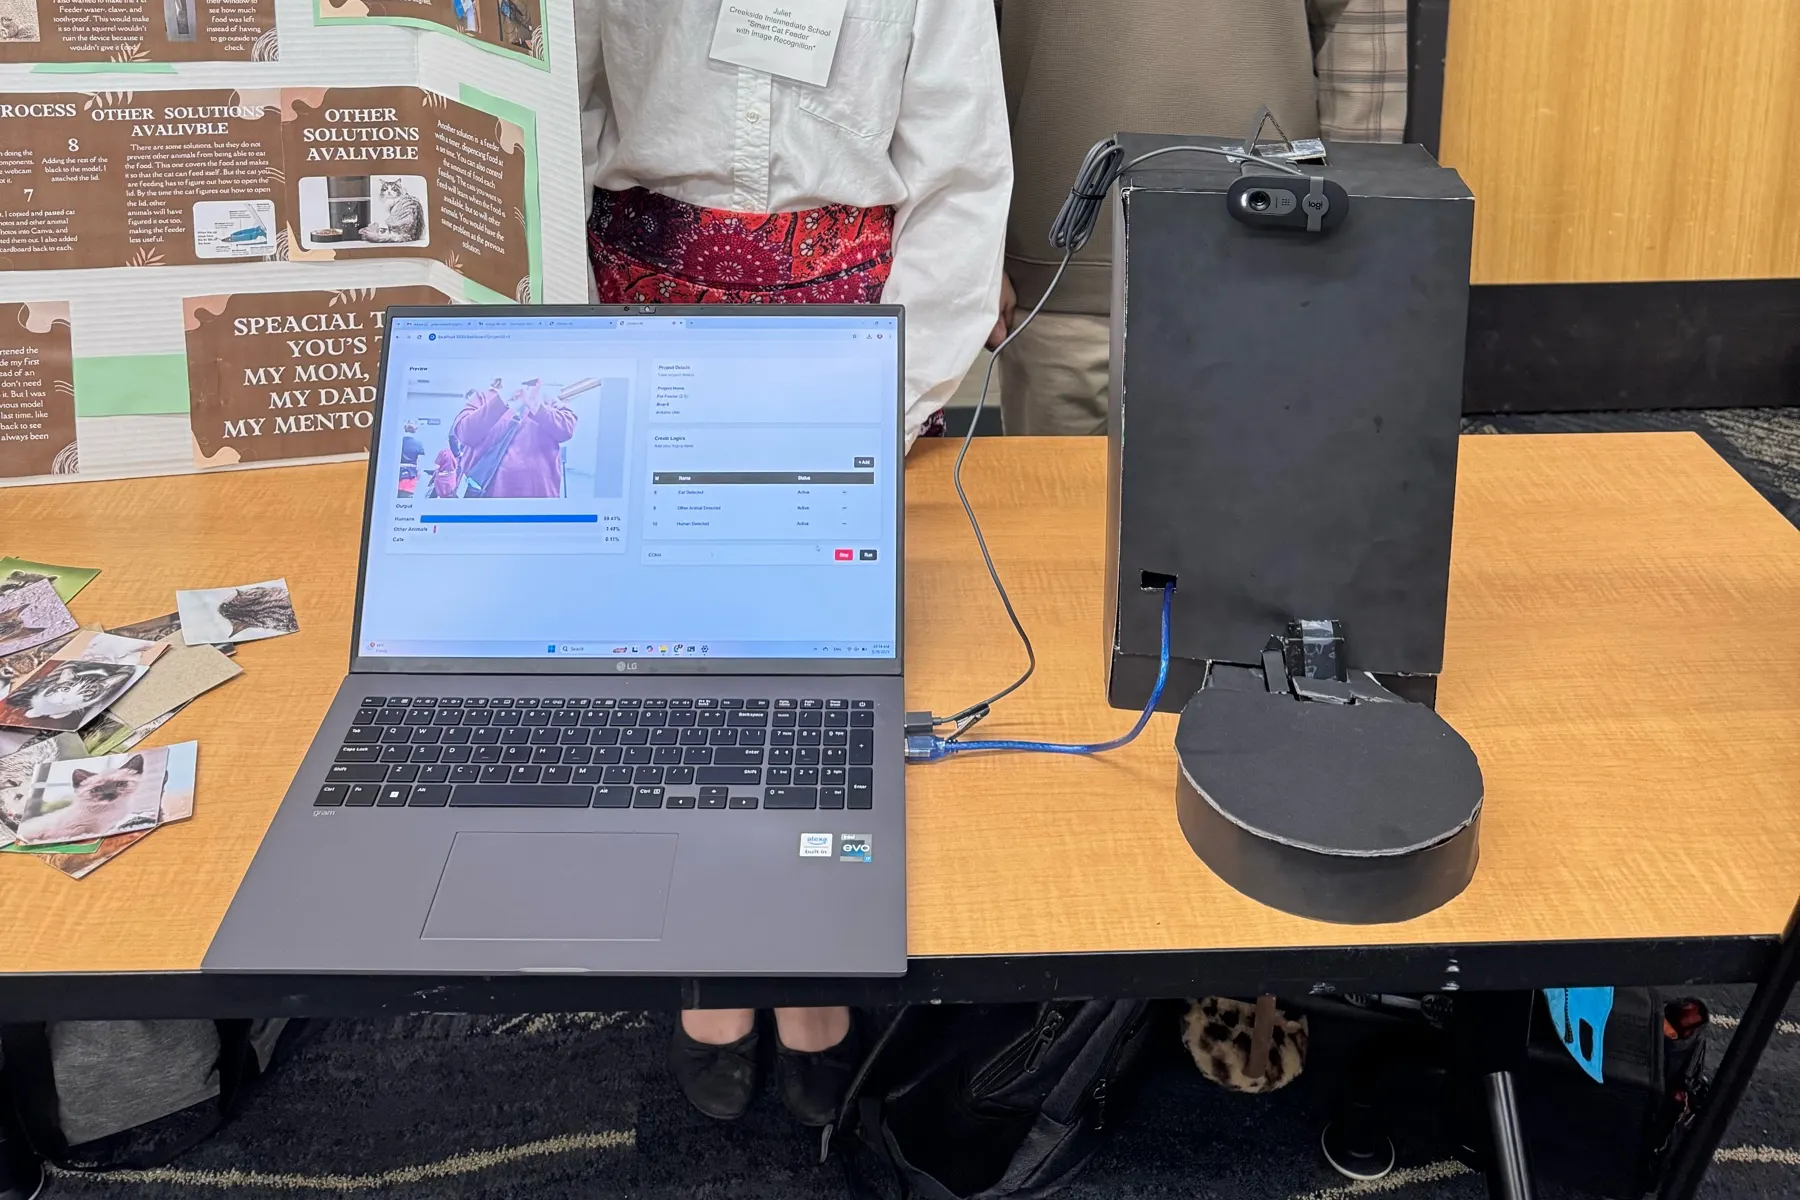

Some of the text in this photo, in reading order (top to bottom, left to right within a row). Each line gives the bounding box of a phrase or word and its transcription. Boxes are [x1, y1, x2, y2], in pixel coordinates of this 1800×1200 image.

[773, 8, 792, 18] Juliet
[730, 6, 831, 36] Creekside Intermediate School
[736, 27, 816, 50] with Image Recognition"
[771, 26, 784, 34] Cat
[785, 29, 809, 40] Feeder
[0, 104, 76, 118] ROCESS
[91, 105, 265, 122] OTHER SOLUTIONS
[325, 108, 398, 123] OTHER
[131, 123, 228, 137] AVALIVBLE
[303, 126, 420, 142] SOLUTIONS
[68, 138, 79, 152] 8
[306, 146, 419, 161] AVALIVBLE
[24, 189, 33, 202] 7
[1308, 200, 1323, 210] logi
[453, 225, 505, 254] problem previous
[234, 311, 363, 337] SPEACIAL
[287, 337, 368, 358] YOU'S
[243, 361, 370, 387] MY MOM,
[268, 391, 314, 410] MY
[222, 419, 268, 439] MY
[1, 433, 28, 441] always
